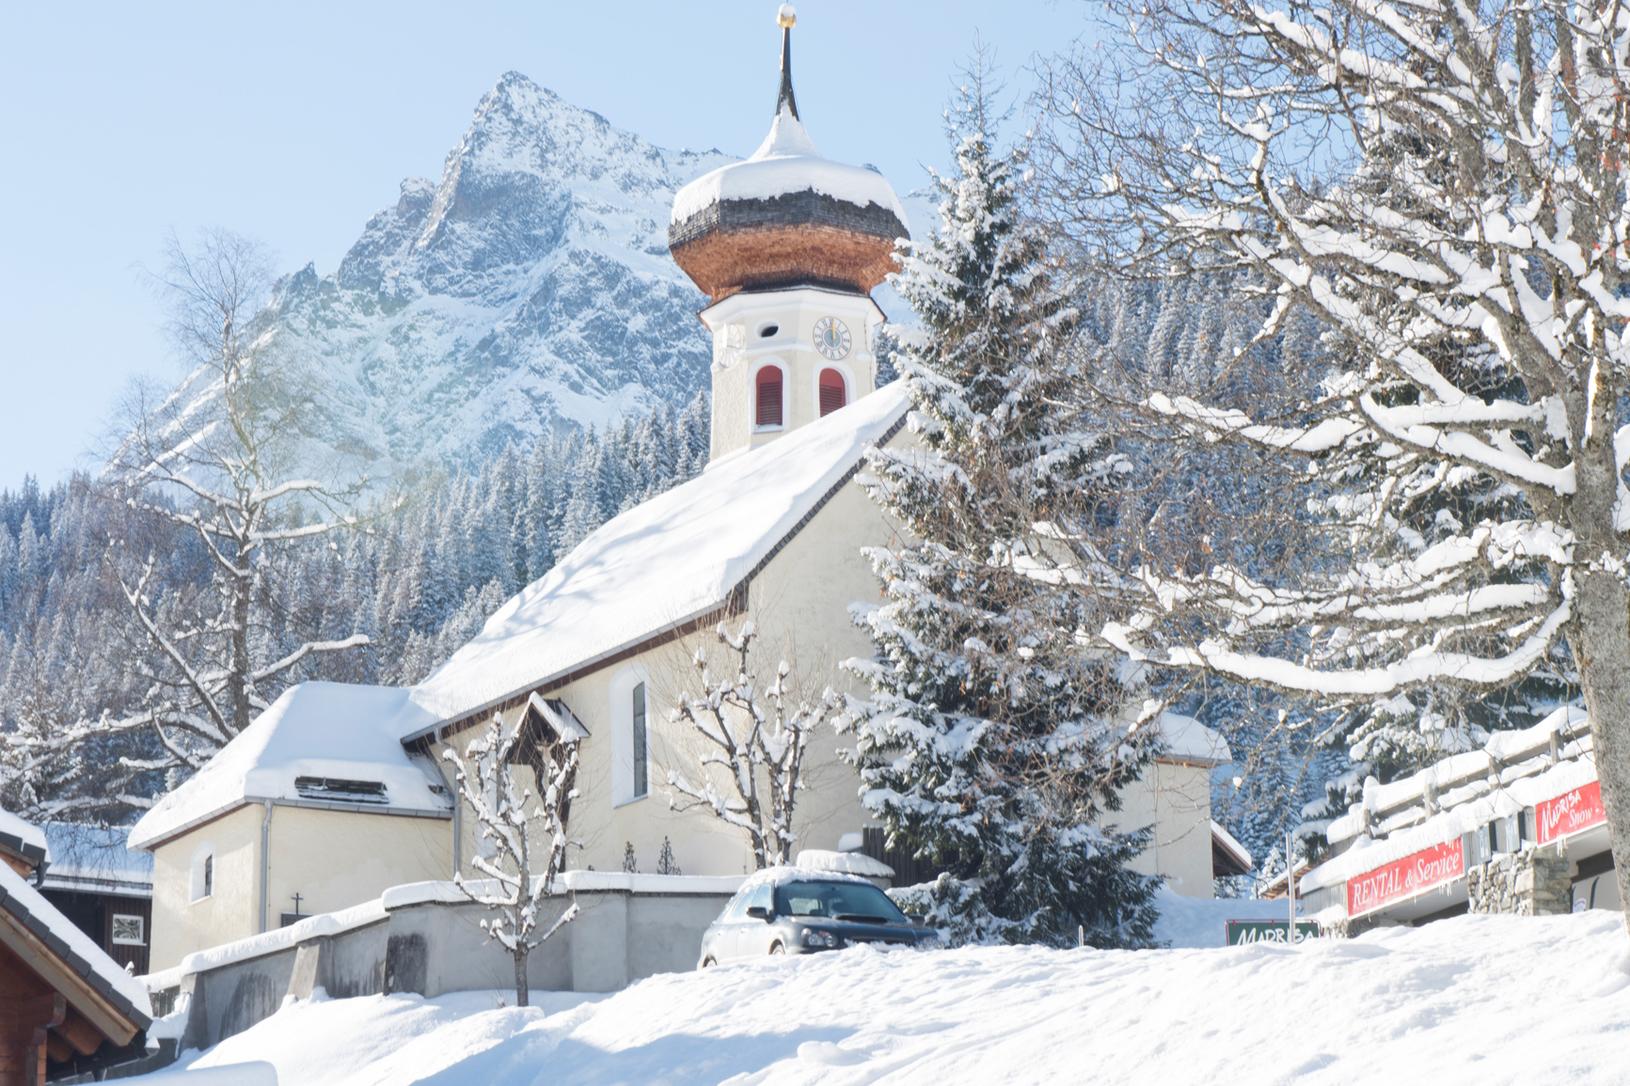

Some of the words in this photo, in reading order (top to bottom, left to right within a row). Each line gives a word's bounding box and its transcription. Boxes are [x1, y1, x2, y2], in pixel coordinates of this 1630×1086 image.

[1541, 789, 1582, 843] MADRISA
[1353, 868, 1401, 905] RENTAL
[1405, 869, 1414, 888] &
[1416, 851, 1460, 884] Service
[1237, 927, 1314, 945] MADRISA
